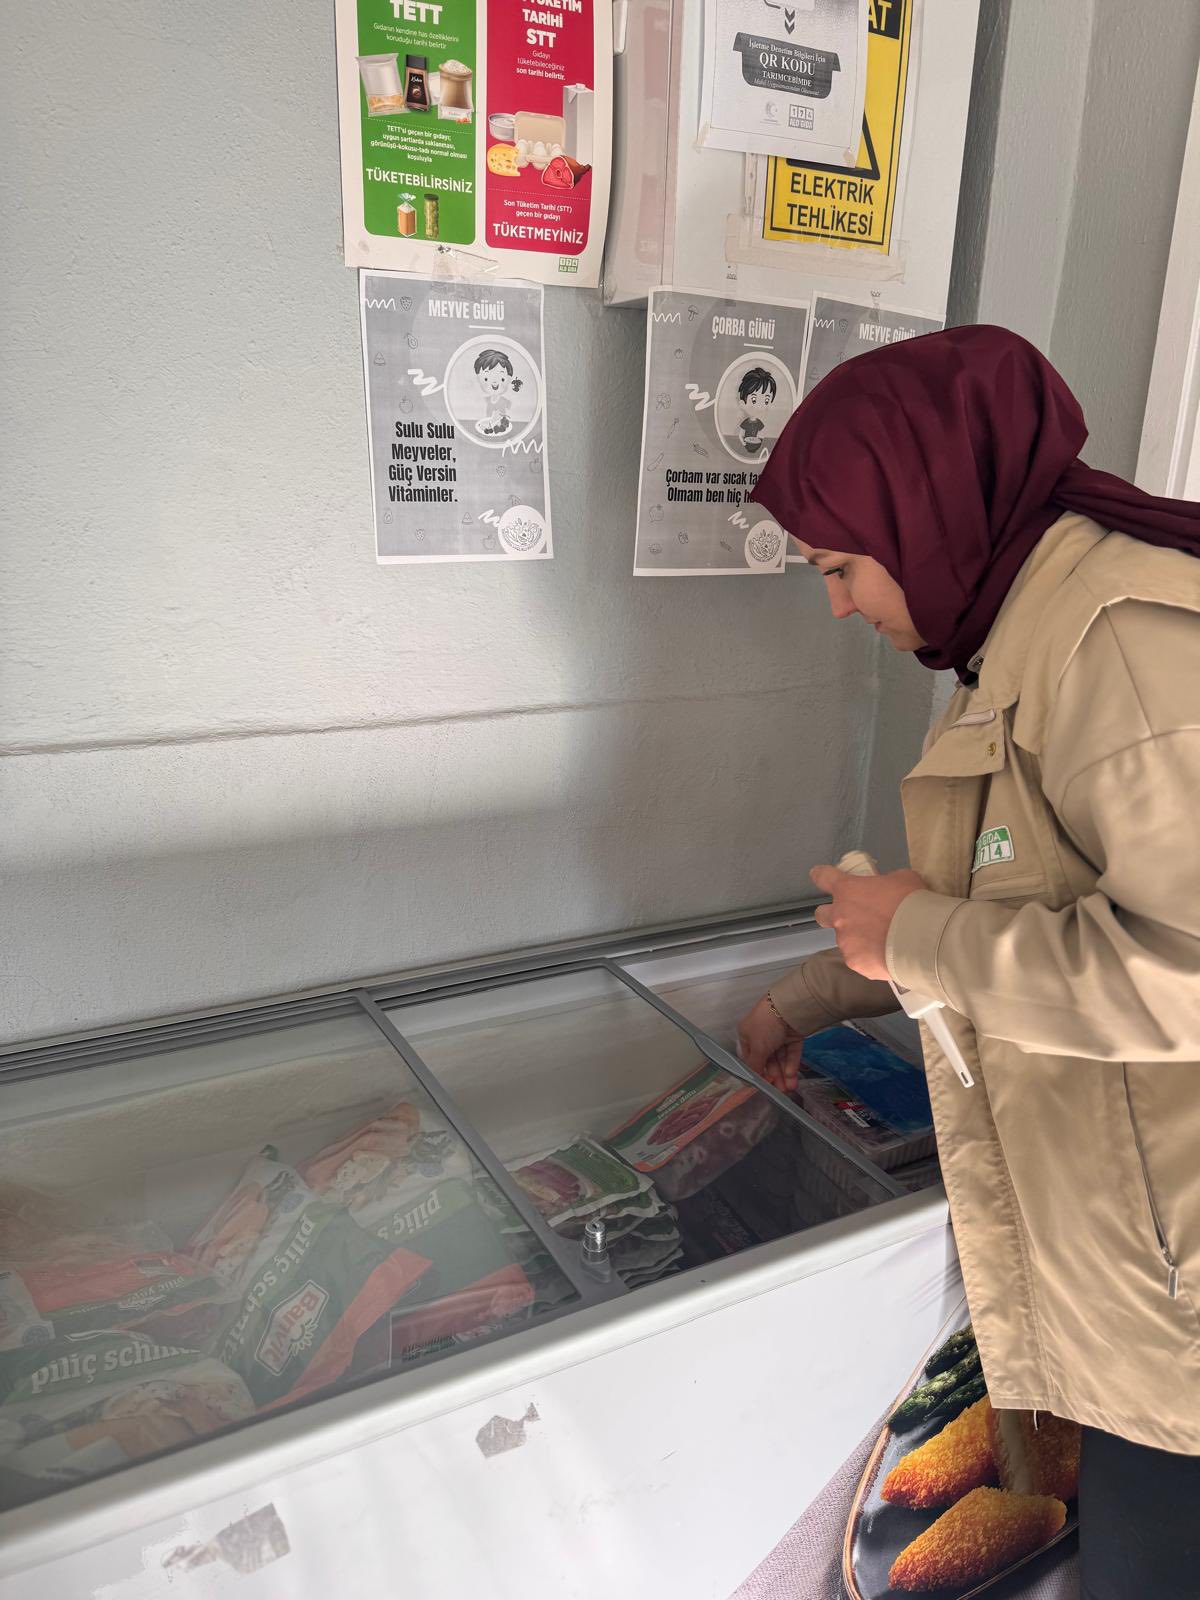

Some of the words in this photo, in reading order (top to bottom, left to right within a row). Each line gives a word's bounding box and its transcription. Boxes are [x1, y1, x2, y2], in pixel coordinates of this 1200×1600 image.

[390, 0, 443, 25] TETT
[522, 8, 564, 28] TARİHİ
[868, 0, 892, 32] AT
[526, 28, 556, 48] STT
[770, 44, 793, 56] Denetim
[516, 67, 527, 75] son
[528, 68, 544, 78] tarihi
[759, 52, 778, 68] QR
[781, 55, 816, 75] KODU
[424, 130, 432, 138] bir
[366, 166, 473, 194] TÜKETEBİLİRSİNİZ
[790, 172, 875, 205] ELEKTRİK
[503, 199, 515, 207] Son
[516, 200, 540, 209] Tüketim
[541, 203, 556, 211] Tarihi
[556, 205, 573, 214] (STT)
[515, 210, 534, 219] geçen
[534, 210, 542, 218] bir
[543, 213, 561, 222] gıdayı
[786, 202, 874, 237] TEHLİKESİ
[493, 221, 584, 245] TÜKETMEYİNİZ
[429, 299, 470, 320] MEYVE
[473, 301, 505, 321] GÜNÜ
[712, 315, 745, 339] ÇORBA
[748, 317, 776, 340] GÜNÜ
[859, 323, 891, 344] MEYVE
[395, 420, 424, 440] Sulu
[427, 422, 455, 440] Sulu
[391, 443, 457, 464] Meyveler,
[388, 464, 413, 486] Güç
[416, 465, 457, 482] Versin
[666, 469, 703, 487] Çorbam
[706, 472, 721, 485] var
[723, 471, 747, 485] sıcak
[388, 485, 458, 503] Vitaminler.
[667, 487, 703, 503] Olmam
[706, 488, 724, 503] ben
[727, 488, 742, 508] hiç
[394, 1187, 442, 1235] piliç
[273, 1213, 317, 1274] piliç
[266, 1290, 321, 1364] Banvit
[31, 1353, 97, 1395] piliç
